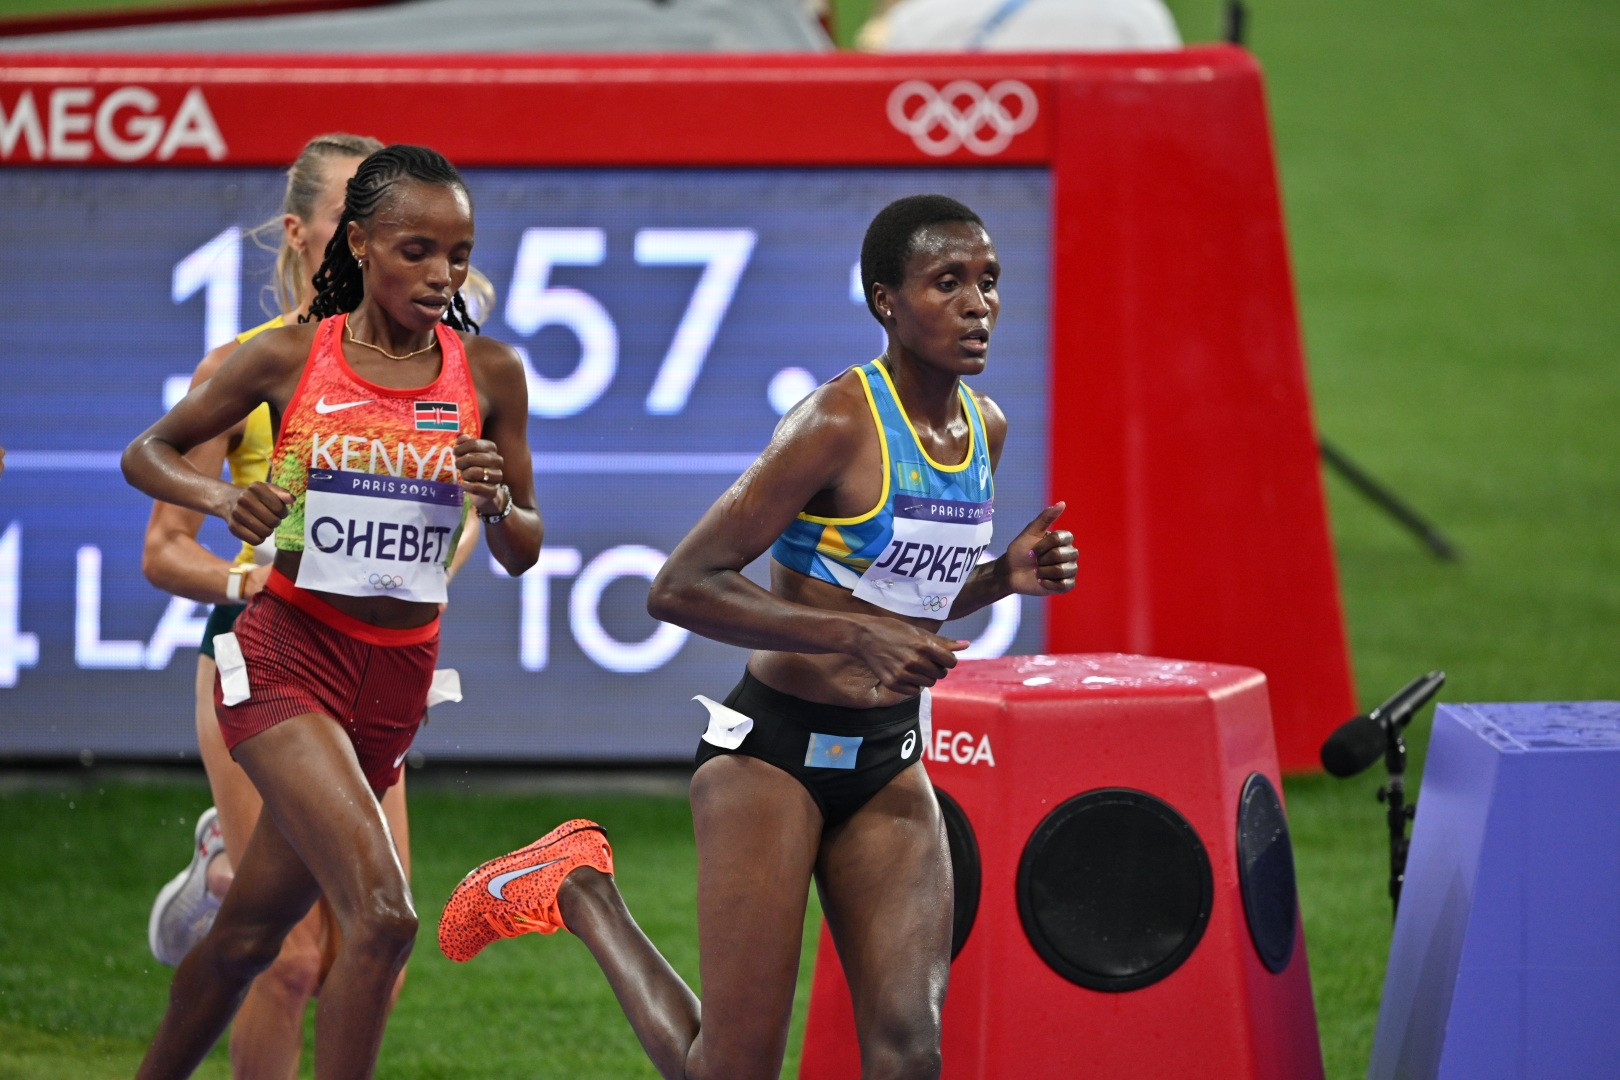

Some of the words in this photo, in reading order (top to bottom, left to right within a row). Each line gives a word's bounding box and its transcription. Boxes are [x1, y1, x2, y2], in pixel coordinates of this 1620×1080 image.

[311, 432, 458, 485] KENYA
[400, 483, 436, 498] 2024
[311, 516, 451, 563] CHEBET
[489, 544, 692, 673] TO
